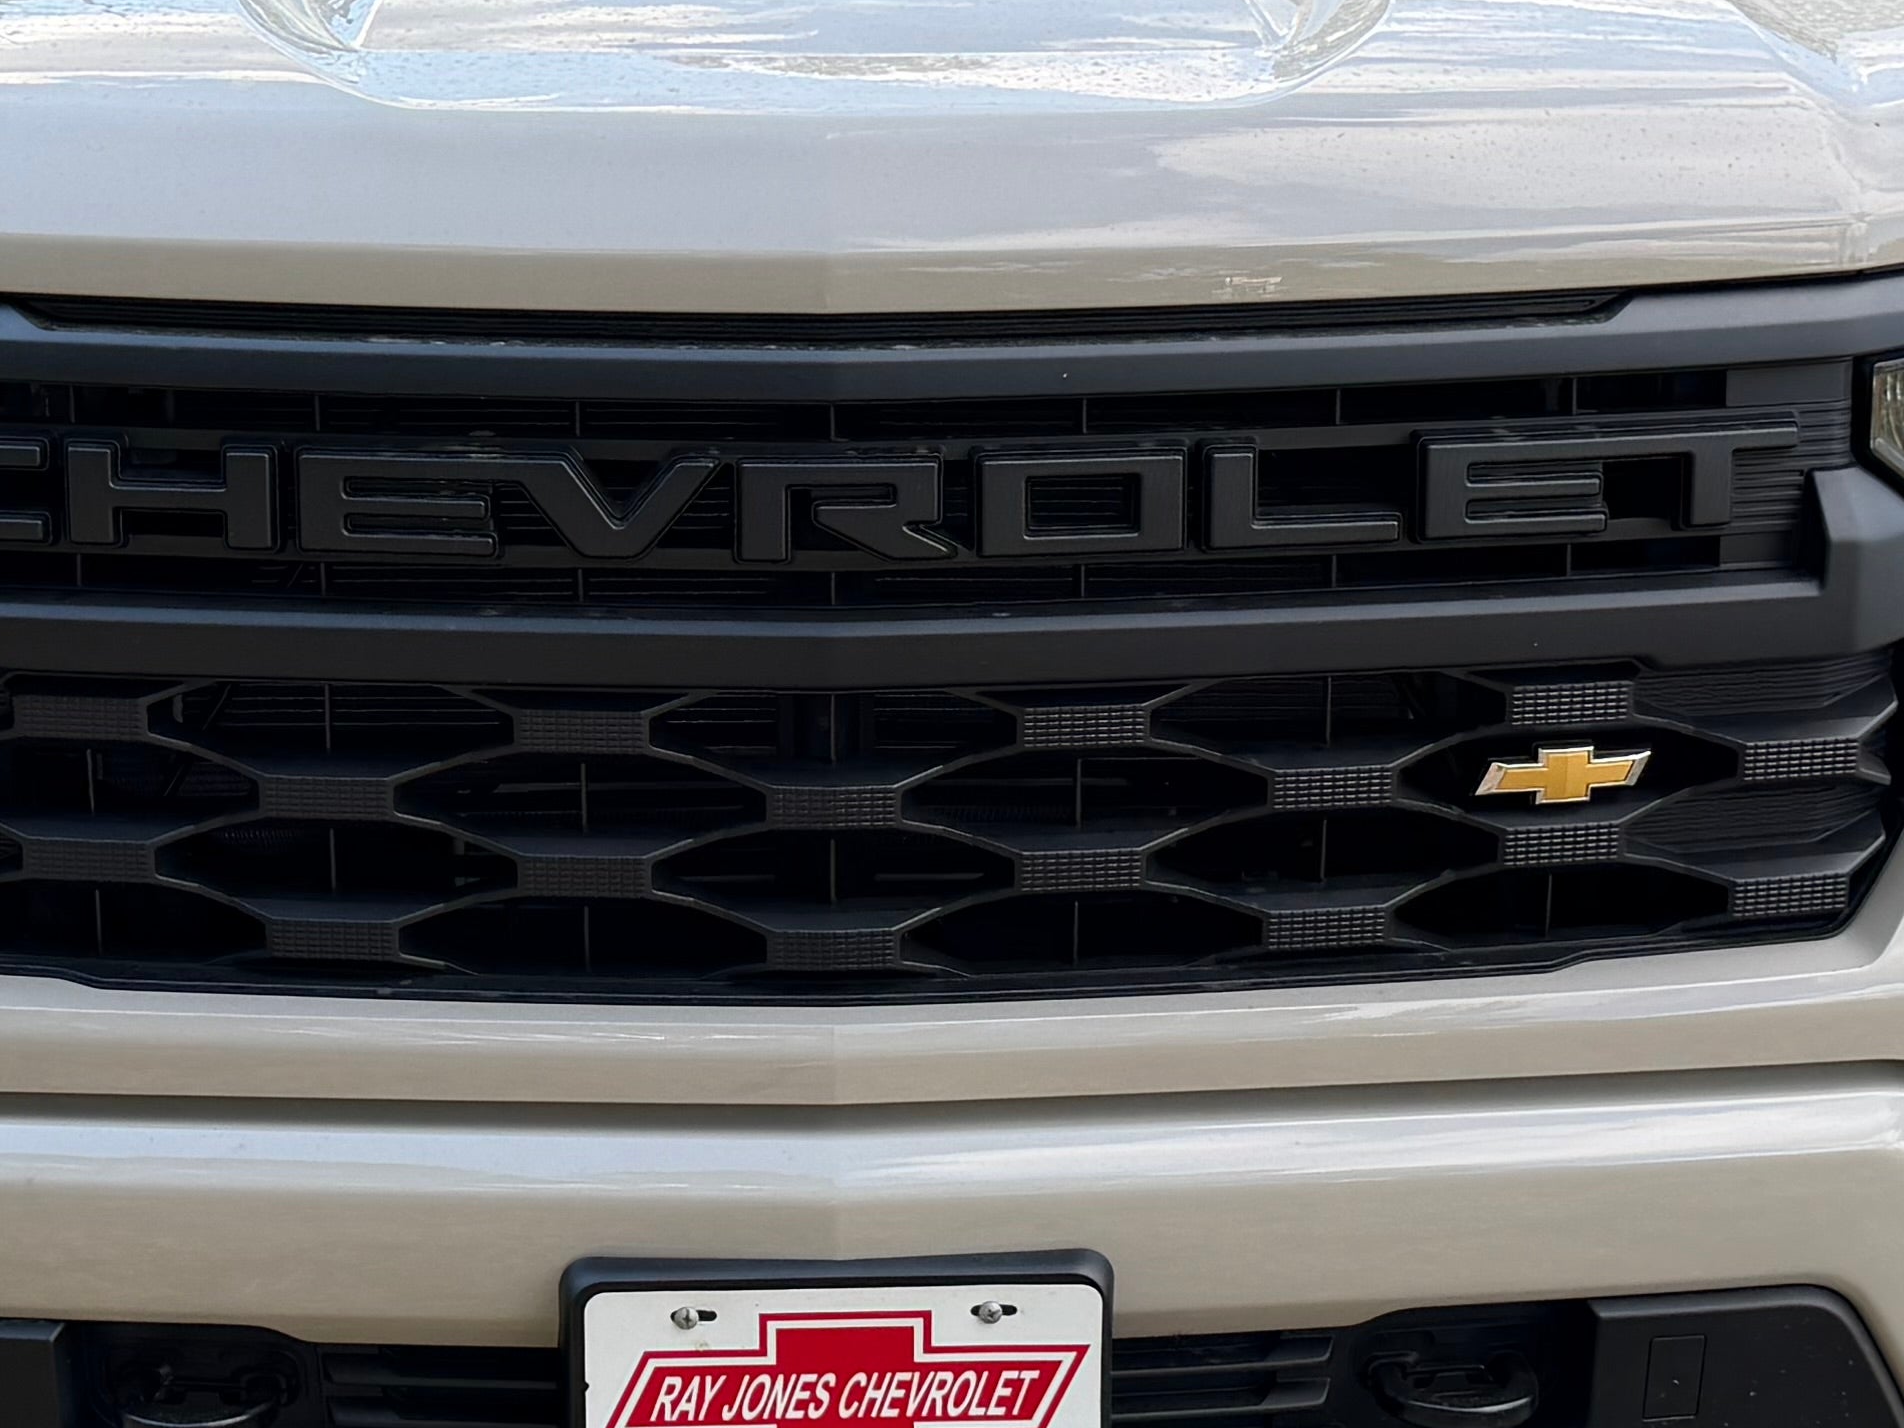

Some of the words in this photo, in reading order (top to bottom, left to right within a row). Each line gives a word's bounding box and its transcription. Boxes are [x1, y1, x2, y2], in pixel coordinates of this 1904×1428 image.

[650, 1374, 727, 1422] RAY
[721, 1372, 836, 1421] JONES
[838, 1370, 1040, 1419] CHEVROLET
